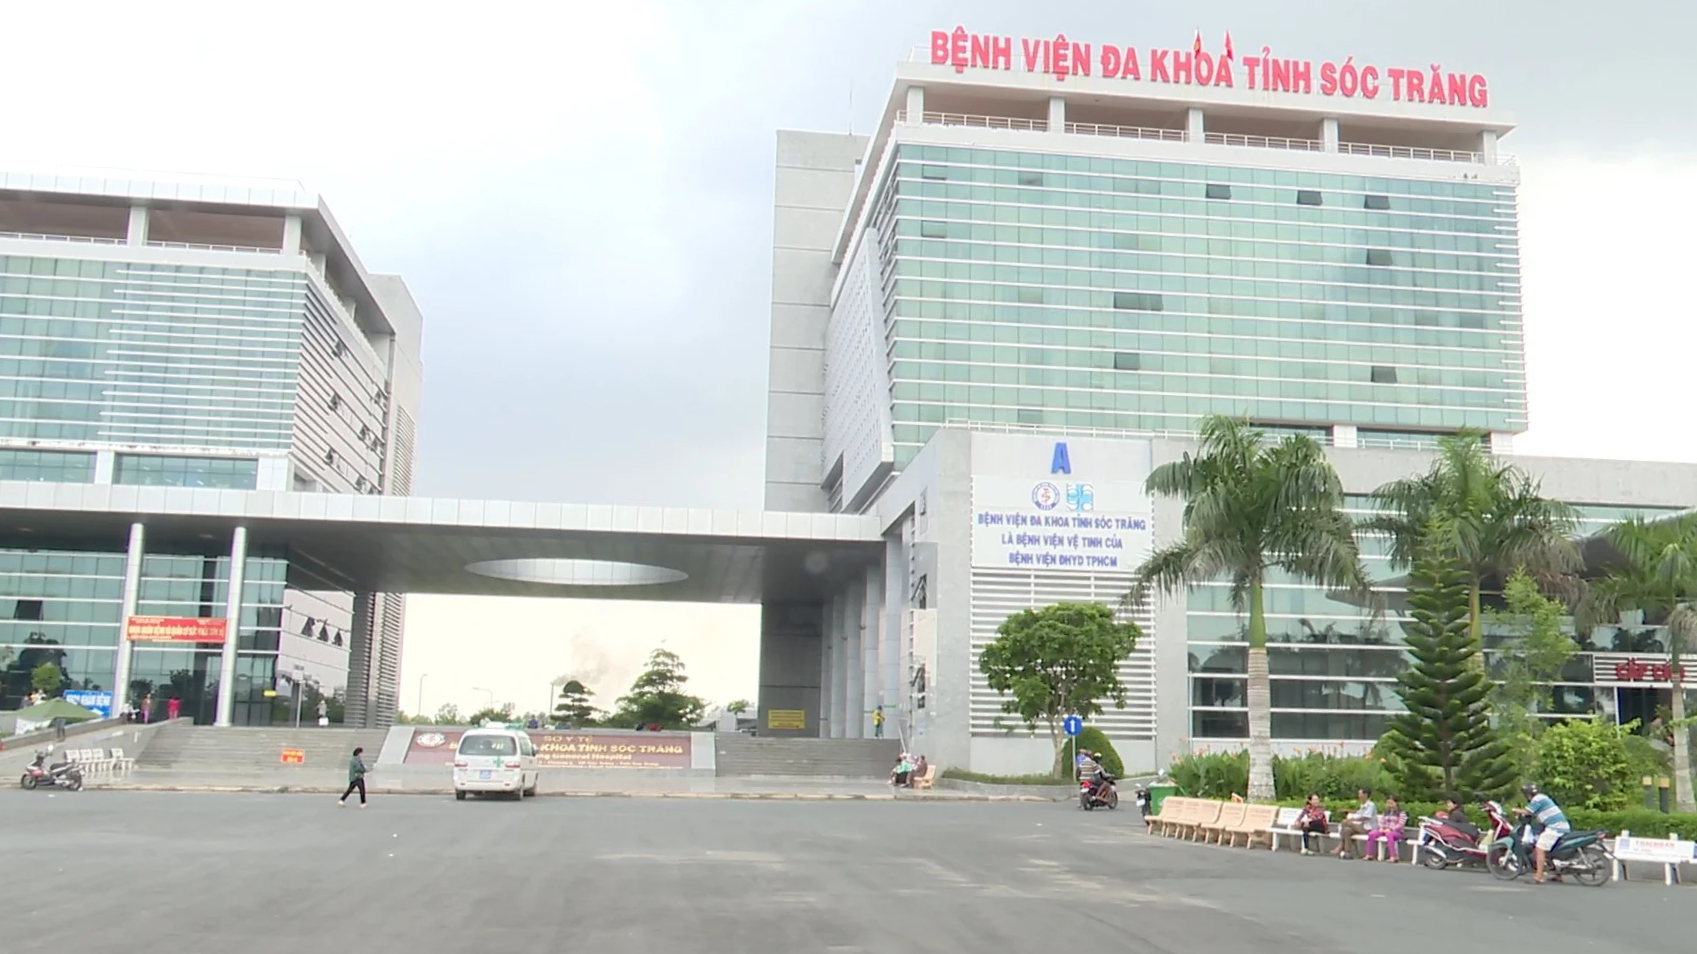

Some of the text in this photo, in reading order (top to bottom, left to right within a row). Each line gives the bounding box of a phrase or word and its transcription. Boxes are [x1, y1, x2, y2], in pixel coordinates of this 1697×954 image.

[931, 26, 1488, 108] BỆNH VIỆN ĐA KHOA TỈNH SÓC TRĂNG
[1051, 442, 1071, 474] A
[978, 511, 1146, 531] BỆNH VIỆN ĐA KHOA TỈNH SÓC TRĂNG
[1002, 532, 1123, 550] LÀ BỆNH VIỆN VỆ TINH CỦA
[1009, 550, 1117, 567] BỆNH VIỆN ĐHYD TPHCM
[540, 743, 576, 752] KHOA
